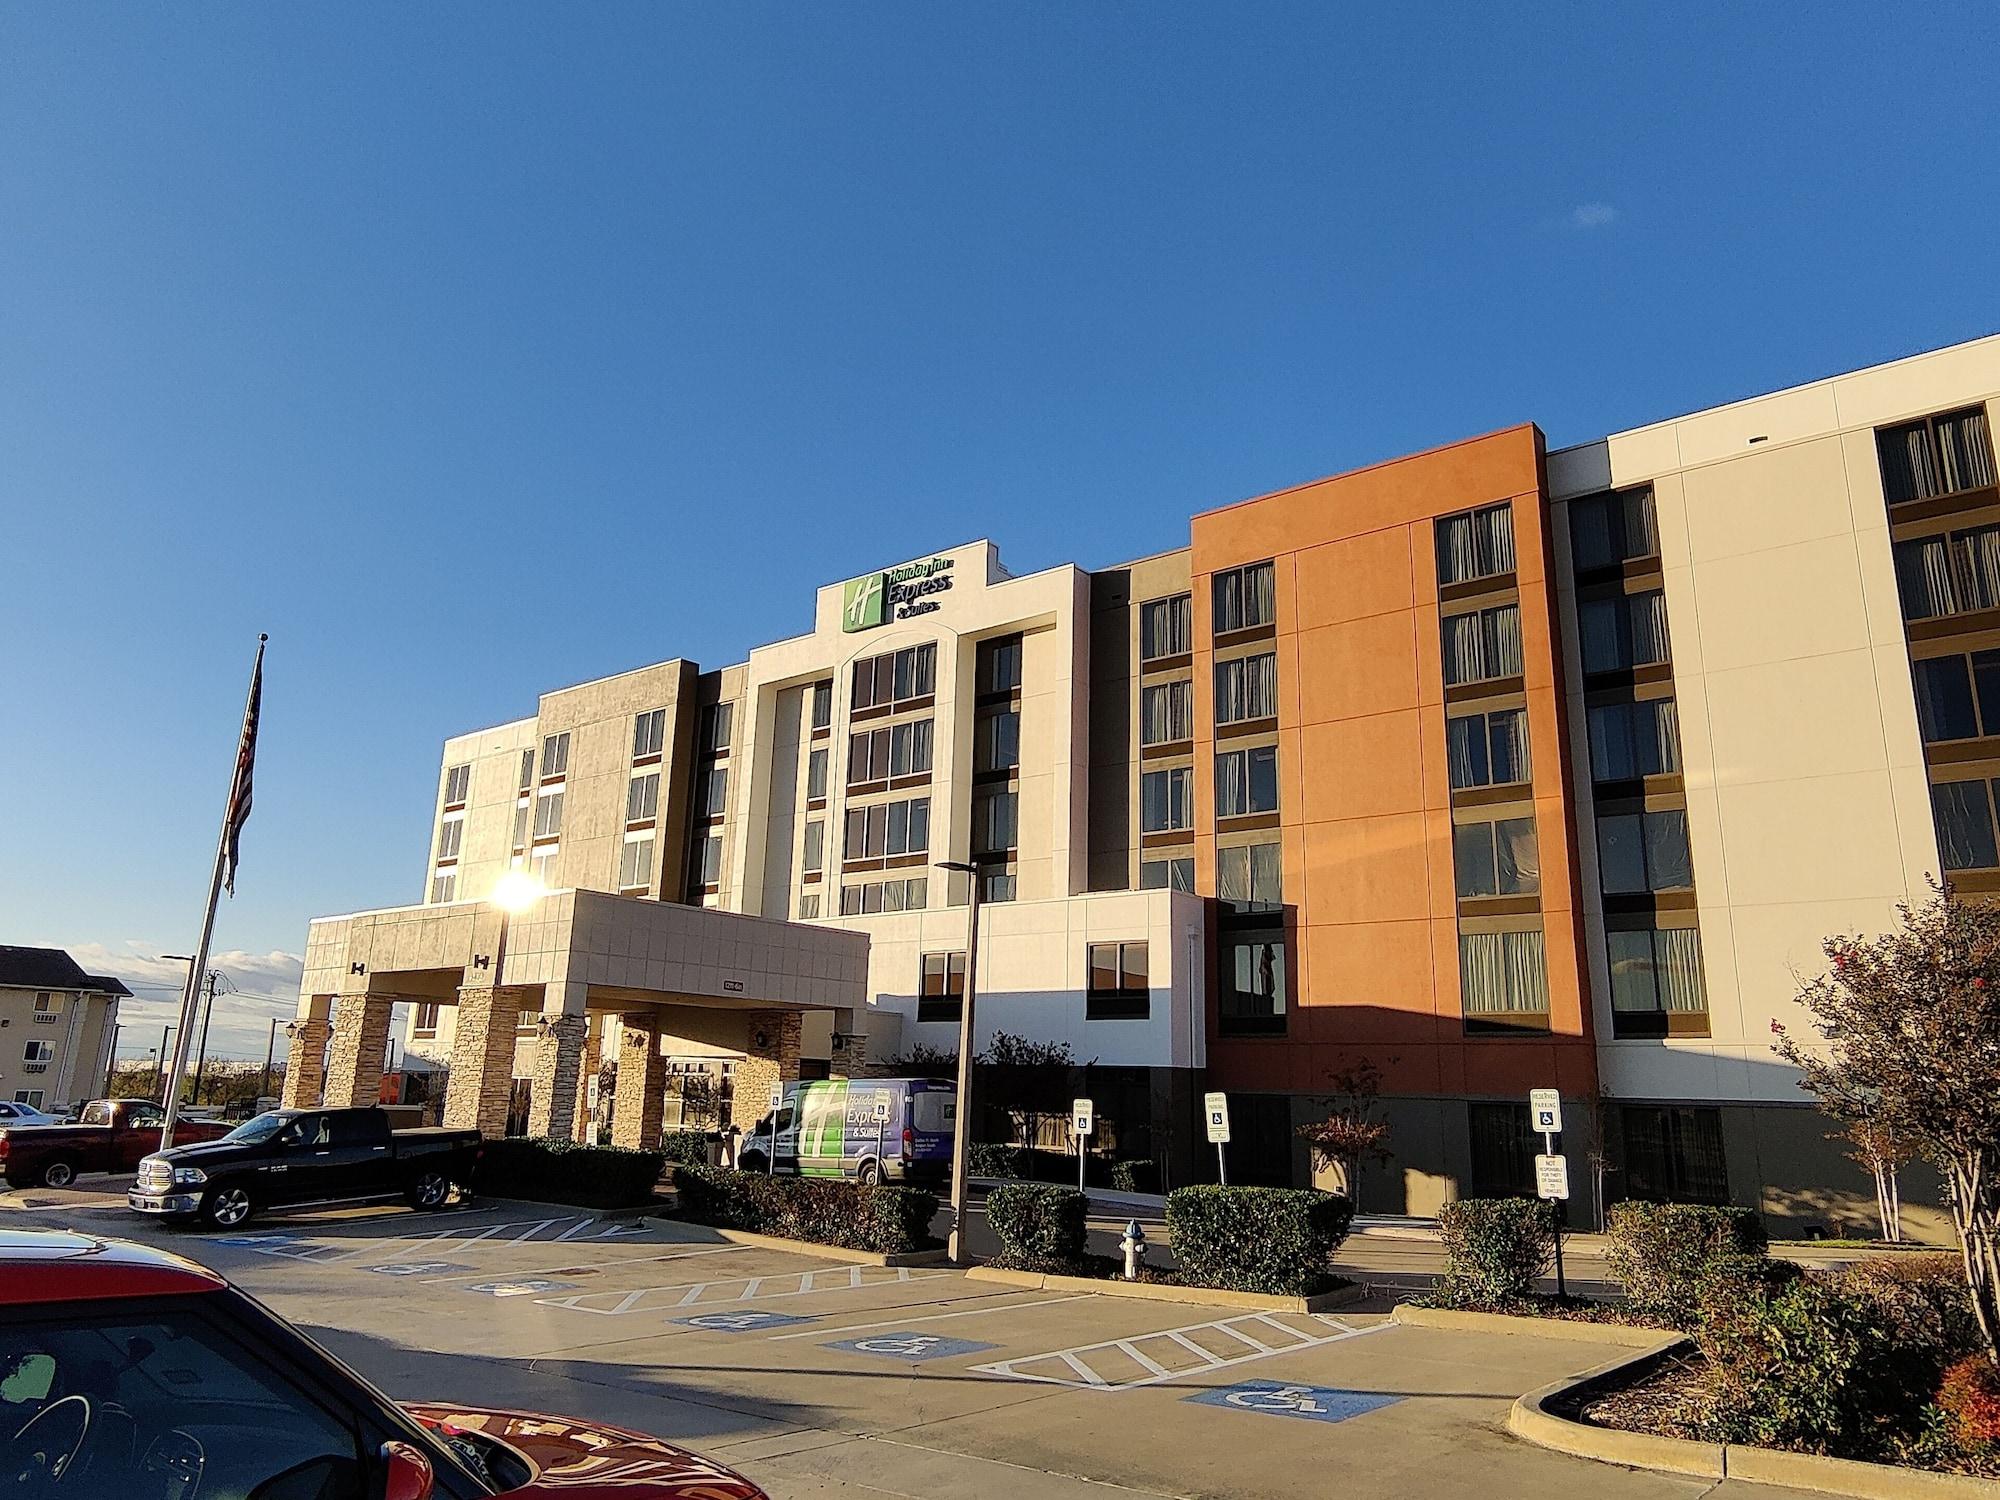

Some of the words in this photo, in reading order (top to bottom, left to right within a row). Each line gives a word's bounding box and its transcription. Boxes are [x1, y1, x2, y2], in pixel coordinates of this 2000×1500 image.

[888, 562, 931, 583] Holiday
[888, 577, 951, 605] Express
[904, 602, 937, 618] Suites
[852, 1127, 859, 1138] &
